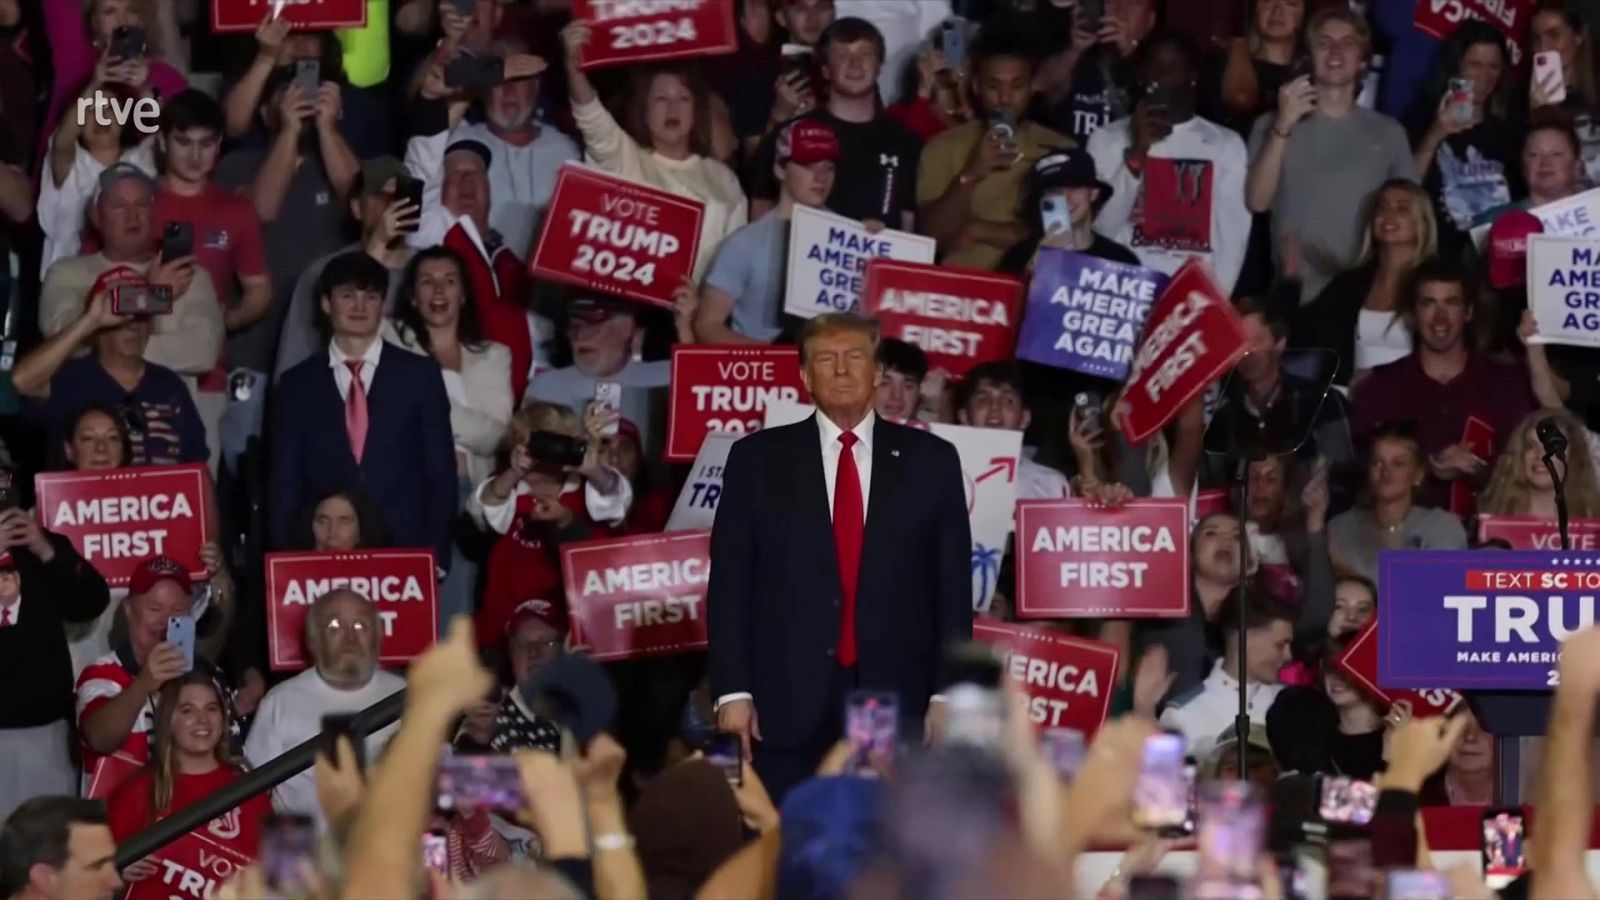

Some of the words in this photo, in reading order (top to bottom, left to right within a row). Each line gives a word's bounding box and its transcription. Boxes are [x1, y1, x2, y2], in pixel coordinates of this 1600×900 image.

[609, 17, 696, 49] 2024
[601, 192, 661, 226] VOTE
[567, 208, 680, 259] TRUMP
[828, 226, 893, 257] MAKE
[570, 243, 657, 286] 2024
[807, 244, 869, 276] AMER
[819, 267, 864, 296] GRE
[1078, 266, 1157, 302] MAKE
[1548, 267, 1600, 288] AME
[815, 288, 862, 314] AGA
[873, 287, 1010, 327] AMERICA
[1050, 286, 1152, 322] AMERIC
[1564, 290, 1600, 310] GR
[1062, 311, 1136, 344] GREA
[1562, 311, 1600, 332] AG
[900, 324, 984, 358] FIRST
[717, 360, 776, 381] VOTE
[1145, 330, 1207, 404] FIRST
[690, 384, 800, 413] TRUMP
[705, 418, 763, 436] 202
[53, 492, 194, 527] AMERICA
[688, 482, 721, 510] TR
[82, 528, 168, 561] FIRST
[1031, 525, 1177, 553] AMERICA
[1530, 533, 1595, 550] VOTE
[582, 557, 712, 597] AMERIC
[1058, 561, 1149, 589] FIRST
[1481, 571, 1536, 589] TEXT
[1540, 571, 1568, 589] SC
[613, 595, 702, 629] FIRST
[1443, 595, 1596, 644] TRU
[1456, 651, 1501, 664] MAKE
[1009, 653, 1099, 698] ERICA
